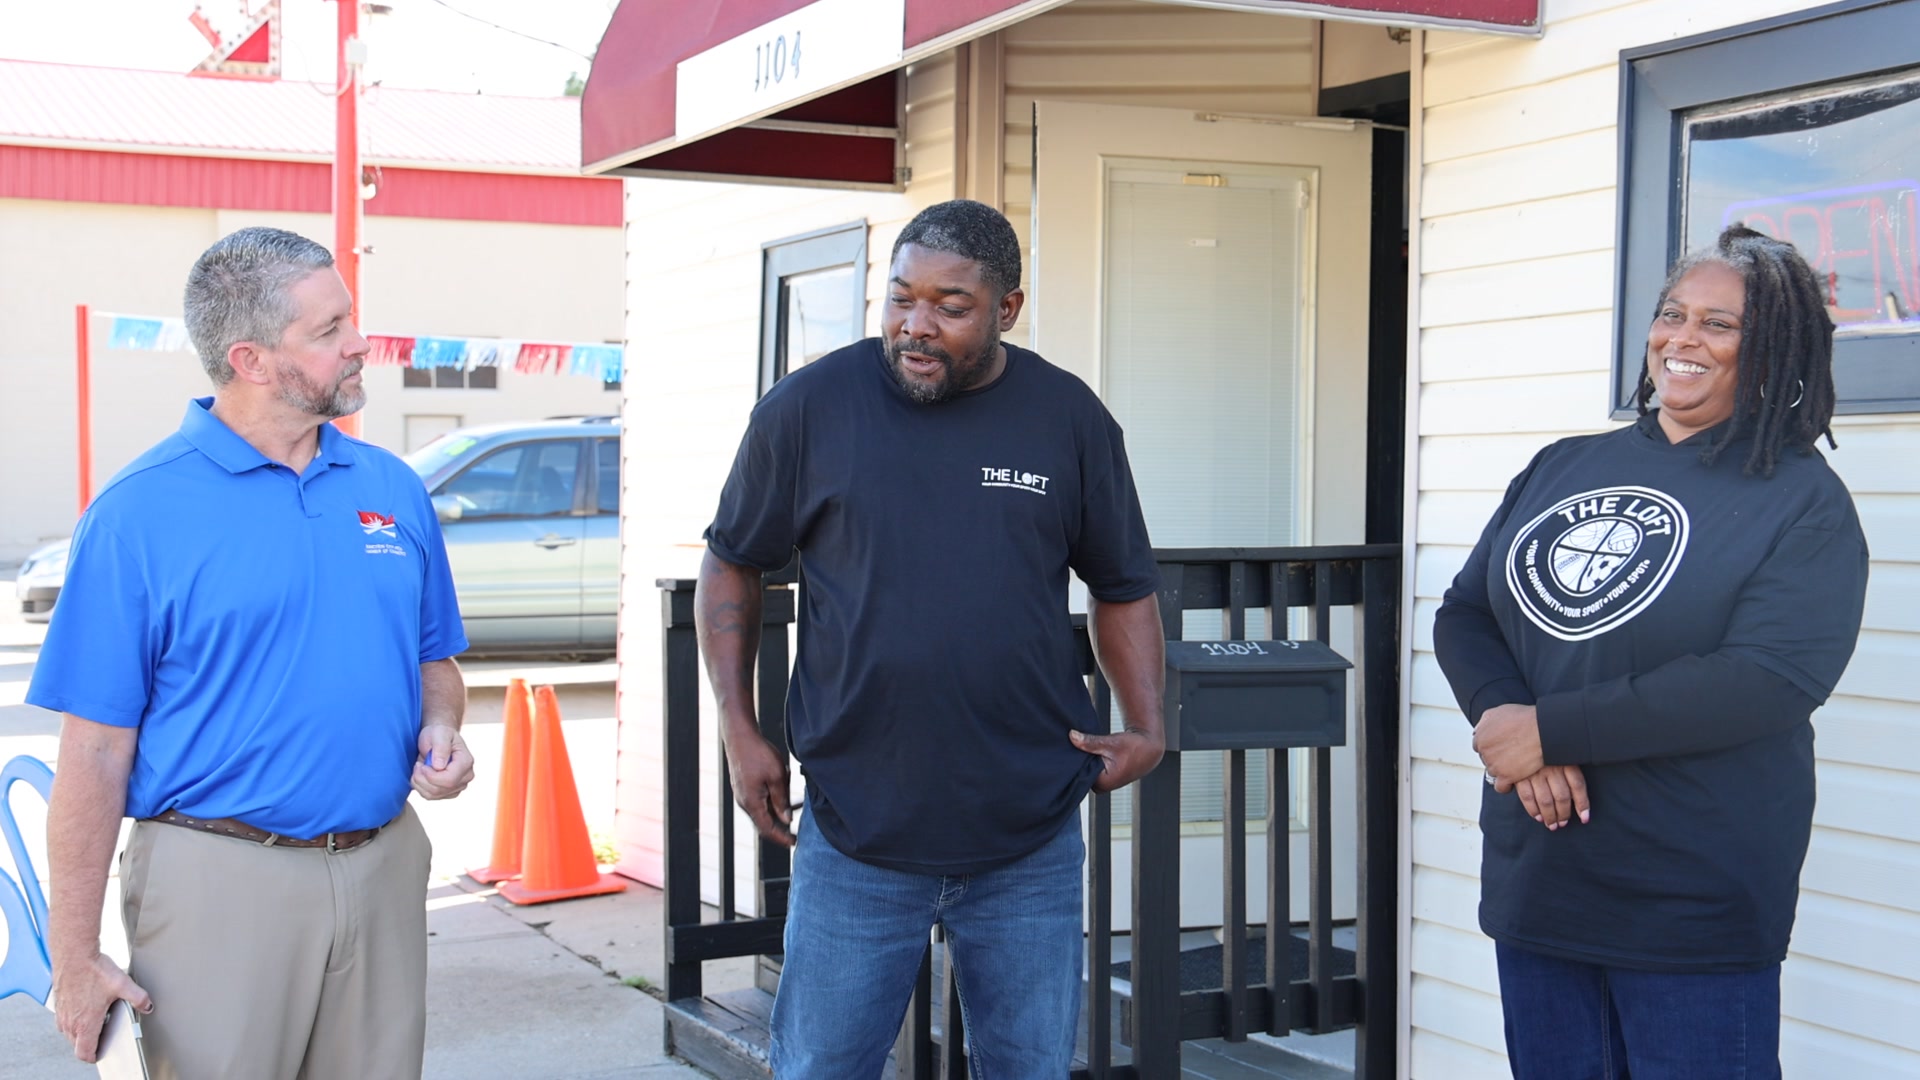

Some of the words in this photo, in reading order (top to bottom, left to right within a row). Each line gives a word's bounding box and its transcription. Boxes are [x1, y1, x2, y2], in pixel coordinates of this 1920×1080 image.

[754, 30, 801, 92] 1104
[981, 467, 1011, 482] THE
[1014, 470, 1049, 489] LOFT
[1557, 497, 1620, 523] THE
[1622, 498, 1671, 535] LOFT
[1525, 544, 1539, 566] YOUR
[1627, 562, 1649, 584] SPOT
[1526, 567, 1561, 611] COMMUNITY
[1606, 581, 1630, 601] YOUR
[1563, 606, 1581, 617] YOUR
[1582, 598, 1604, 617] SPORT
[1201, 641, 1268, 656] 1104
